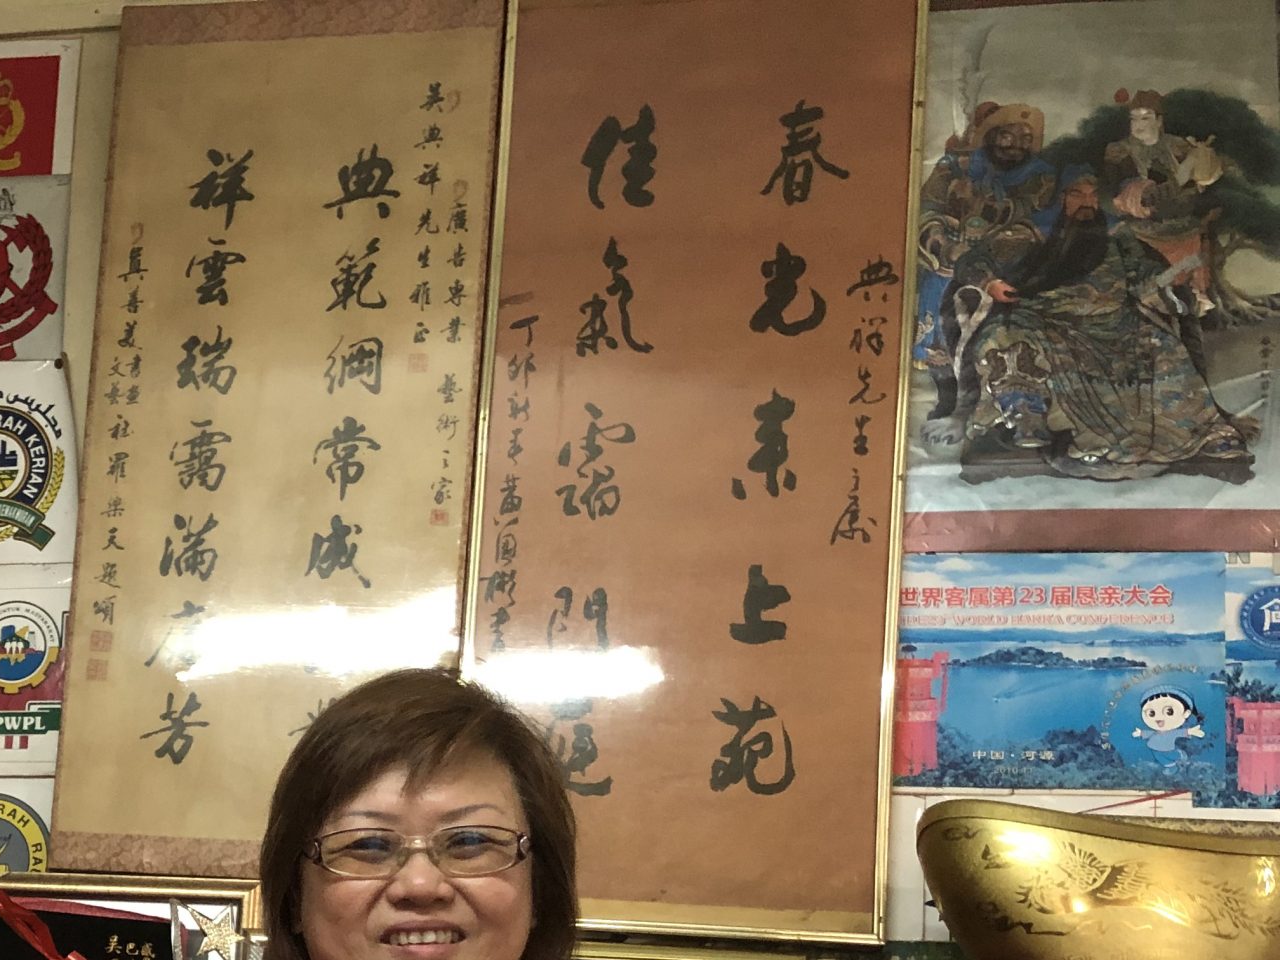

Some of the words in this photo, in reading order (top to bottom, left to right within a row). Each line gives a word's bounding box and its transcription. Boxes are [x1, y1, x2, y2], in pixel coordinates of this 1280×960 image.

[23, 433, 45, 499] KERIAN
[900, 585, 1175, 608] 世界客属第23届恳亲大会
